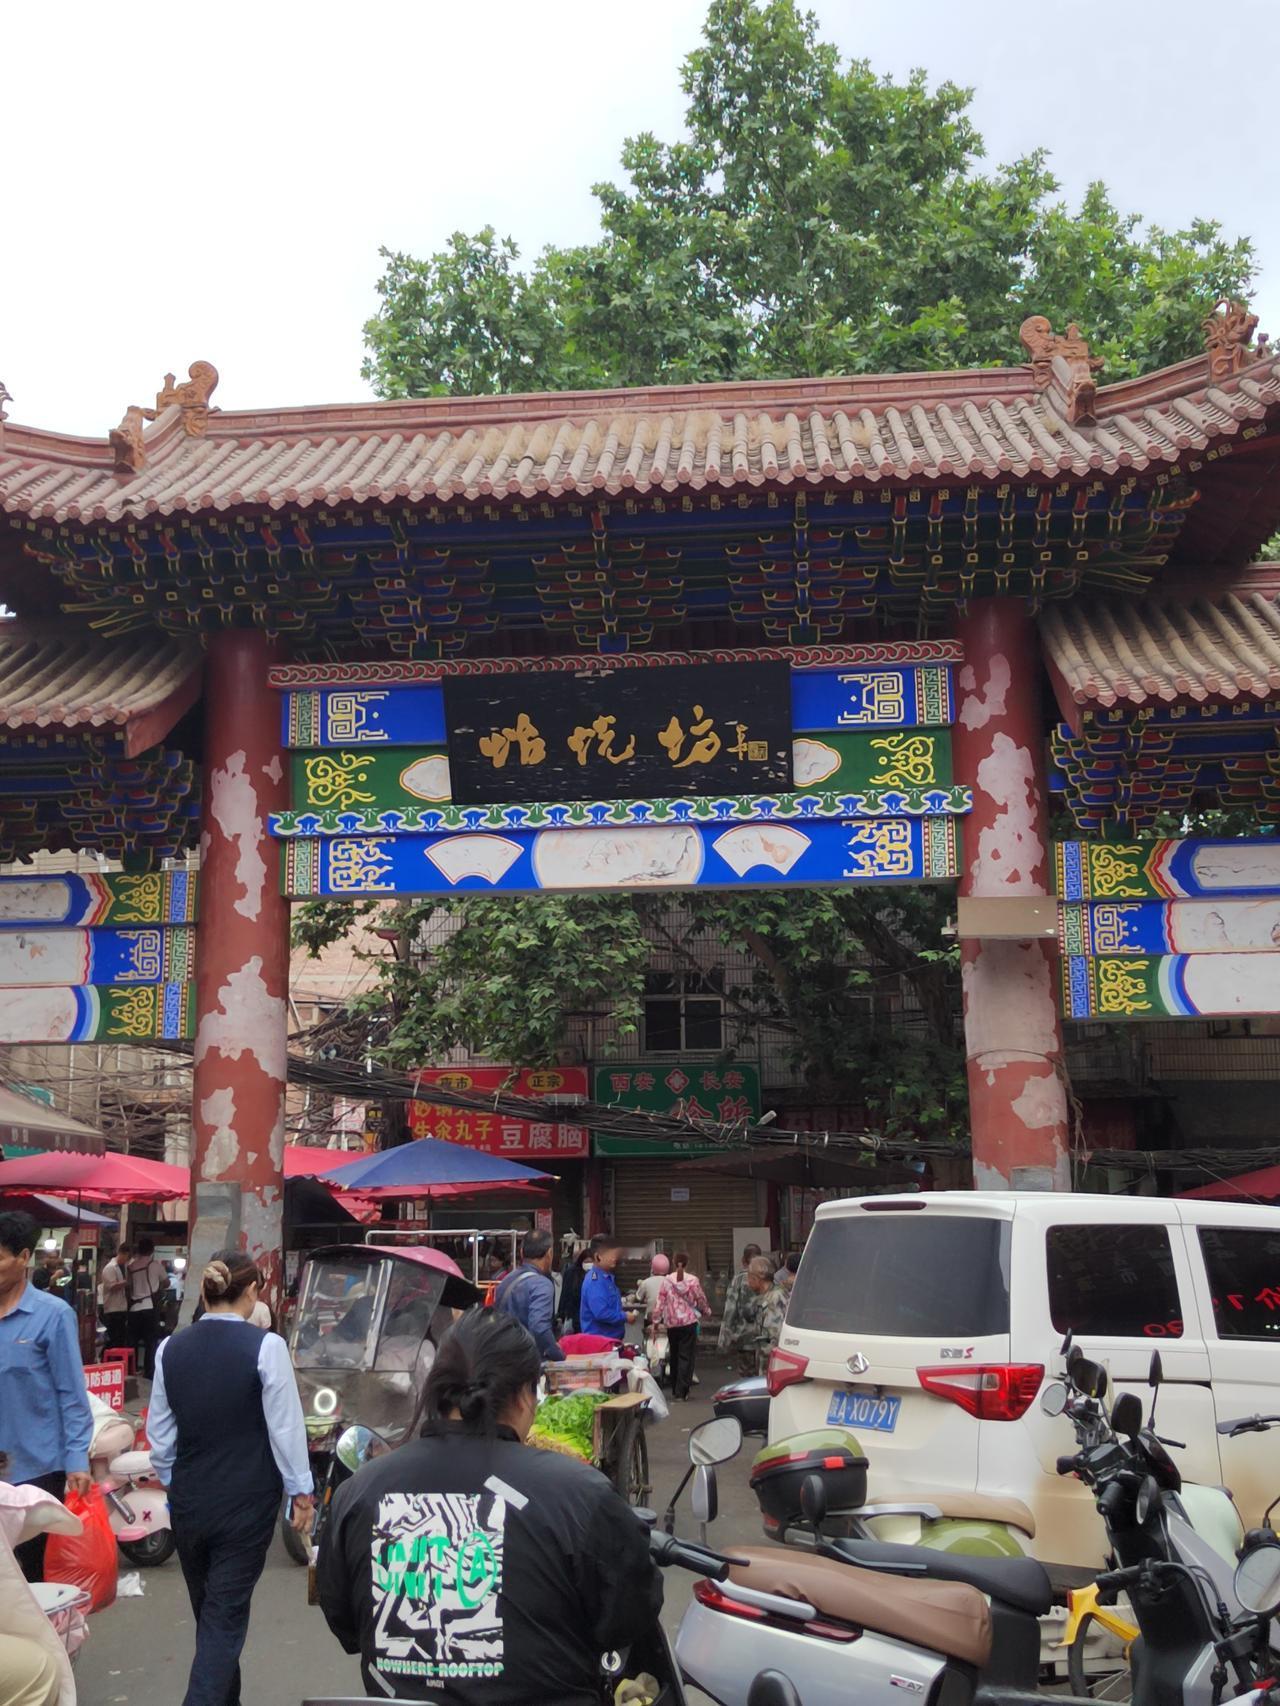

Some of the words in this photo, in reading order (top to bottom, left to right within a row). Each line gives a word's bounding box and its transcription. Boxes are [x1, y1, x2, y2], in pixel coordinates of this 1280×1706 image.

[532, 1075, 561, 1088] 正宗
[610, 1073, 656, 1092] 西安
[702, 1070, 745, 1091] 长安
[500, 1123, 583, 1149] 豆腐脑
[438, 1661, 504, 1678] ROOFTOP
